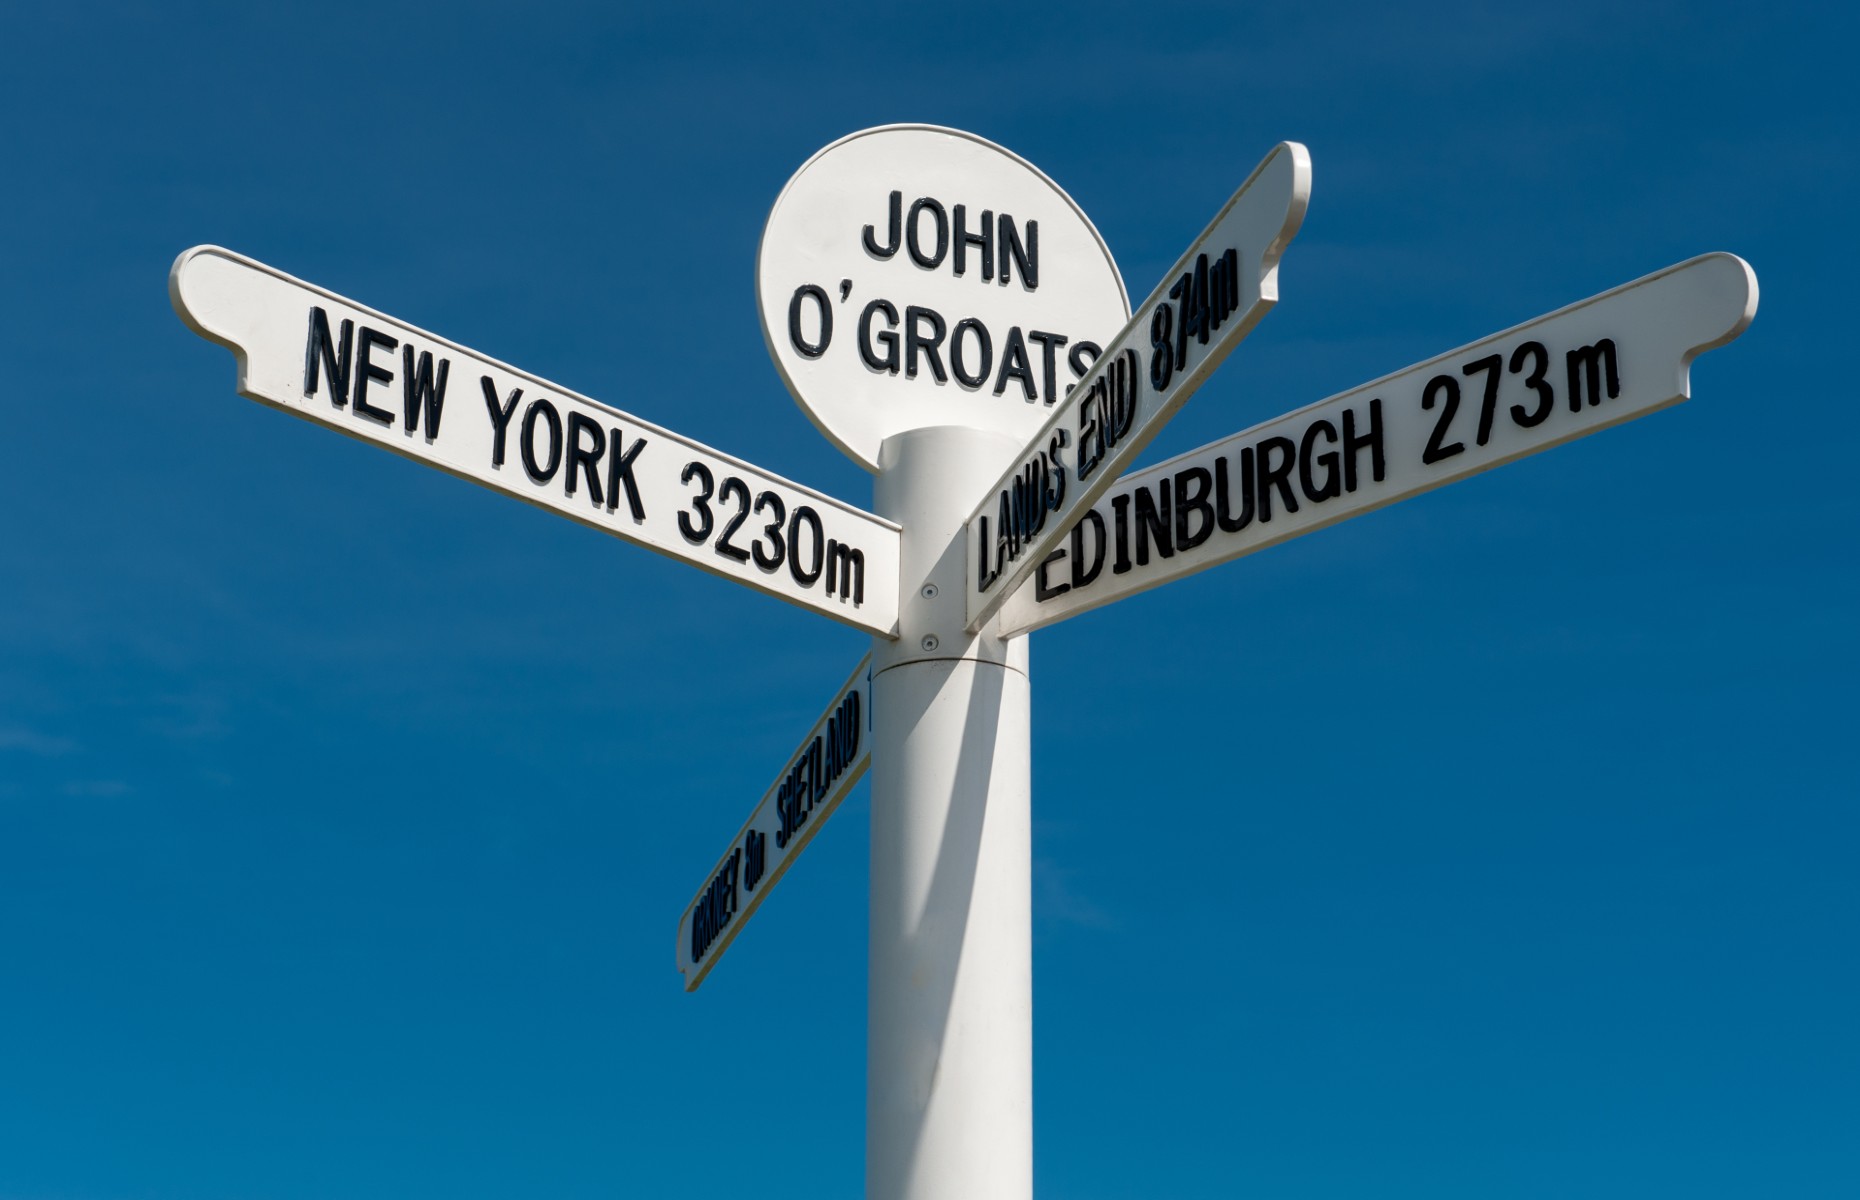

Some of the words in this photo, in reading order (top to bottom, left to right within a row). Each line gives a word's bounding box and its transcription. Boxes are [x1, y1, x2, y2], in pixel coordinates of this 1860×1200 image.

[863, 190, 1038, 289] JOHN
[304, 305, 450, 440] NEW
[480, 375, 648, 520] YORK
[678, 461, 865, 605] 3230m
[978, 428, 1066, 592] LANDS
[1078, 348, 1137, 481] END
[1151, 248, 1239, 392] 874m
[1035, 398, 1386, 603] EDINBURGH
[691, 847, 741, 964] ORKNEY
[775, 690, 860, 850] SHETLAND
